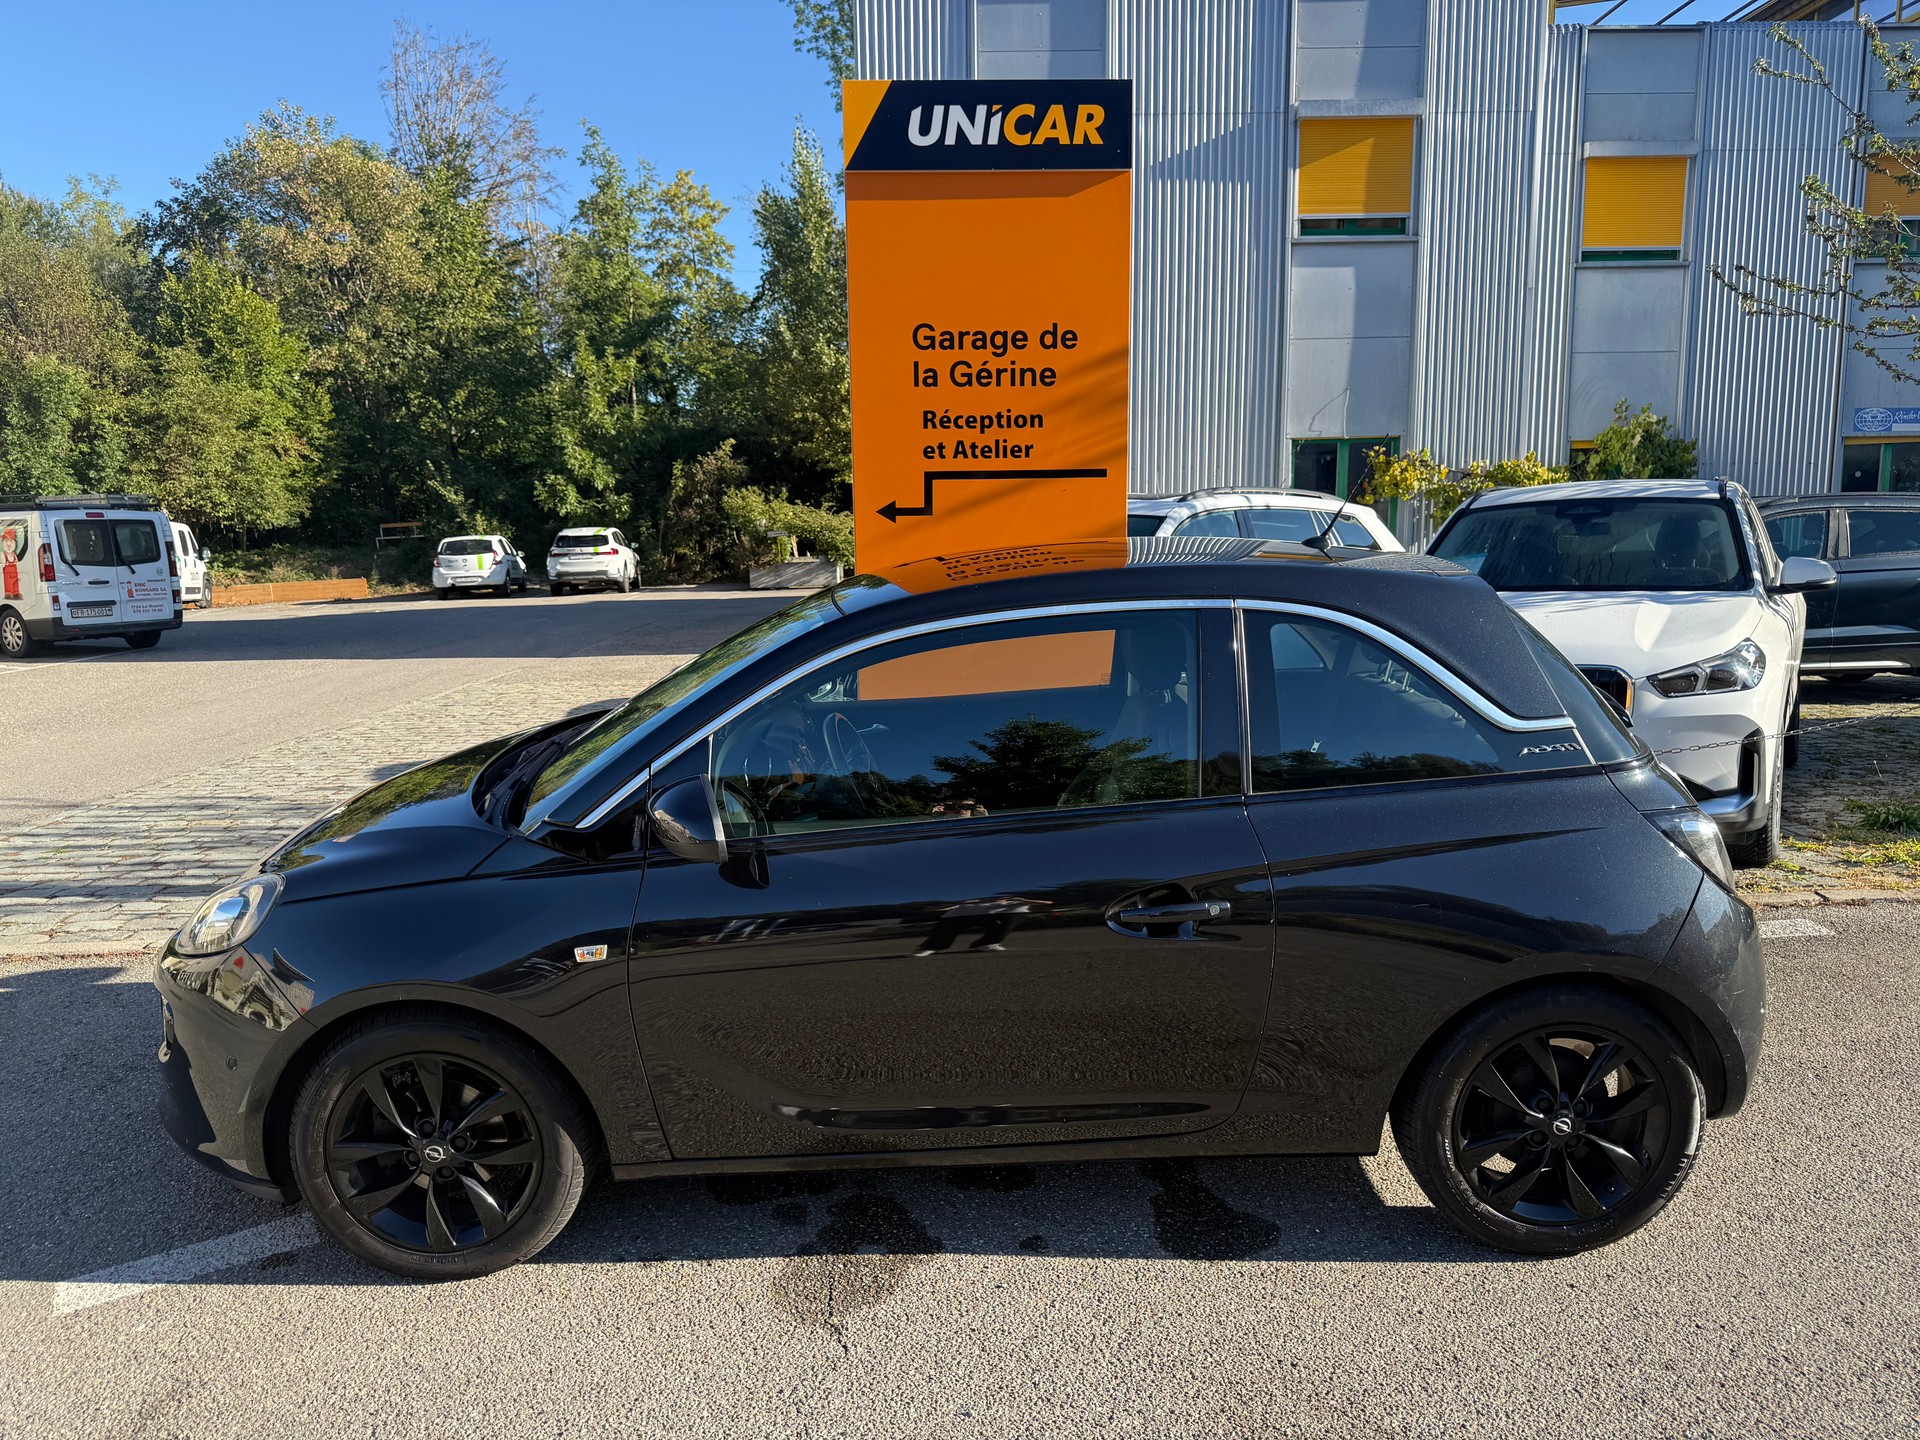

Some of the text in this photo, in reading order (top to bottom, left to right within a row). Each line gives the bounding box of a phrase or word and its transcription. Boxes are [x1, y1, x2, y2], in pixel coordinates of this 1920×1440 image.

[912, 322, 1078, 358] Garage de
[913, 360, 1057, 387] la Gérine
[922, 408, 1044, 434] Réception
[922, 438, 1034, 459] et Atelier
